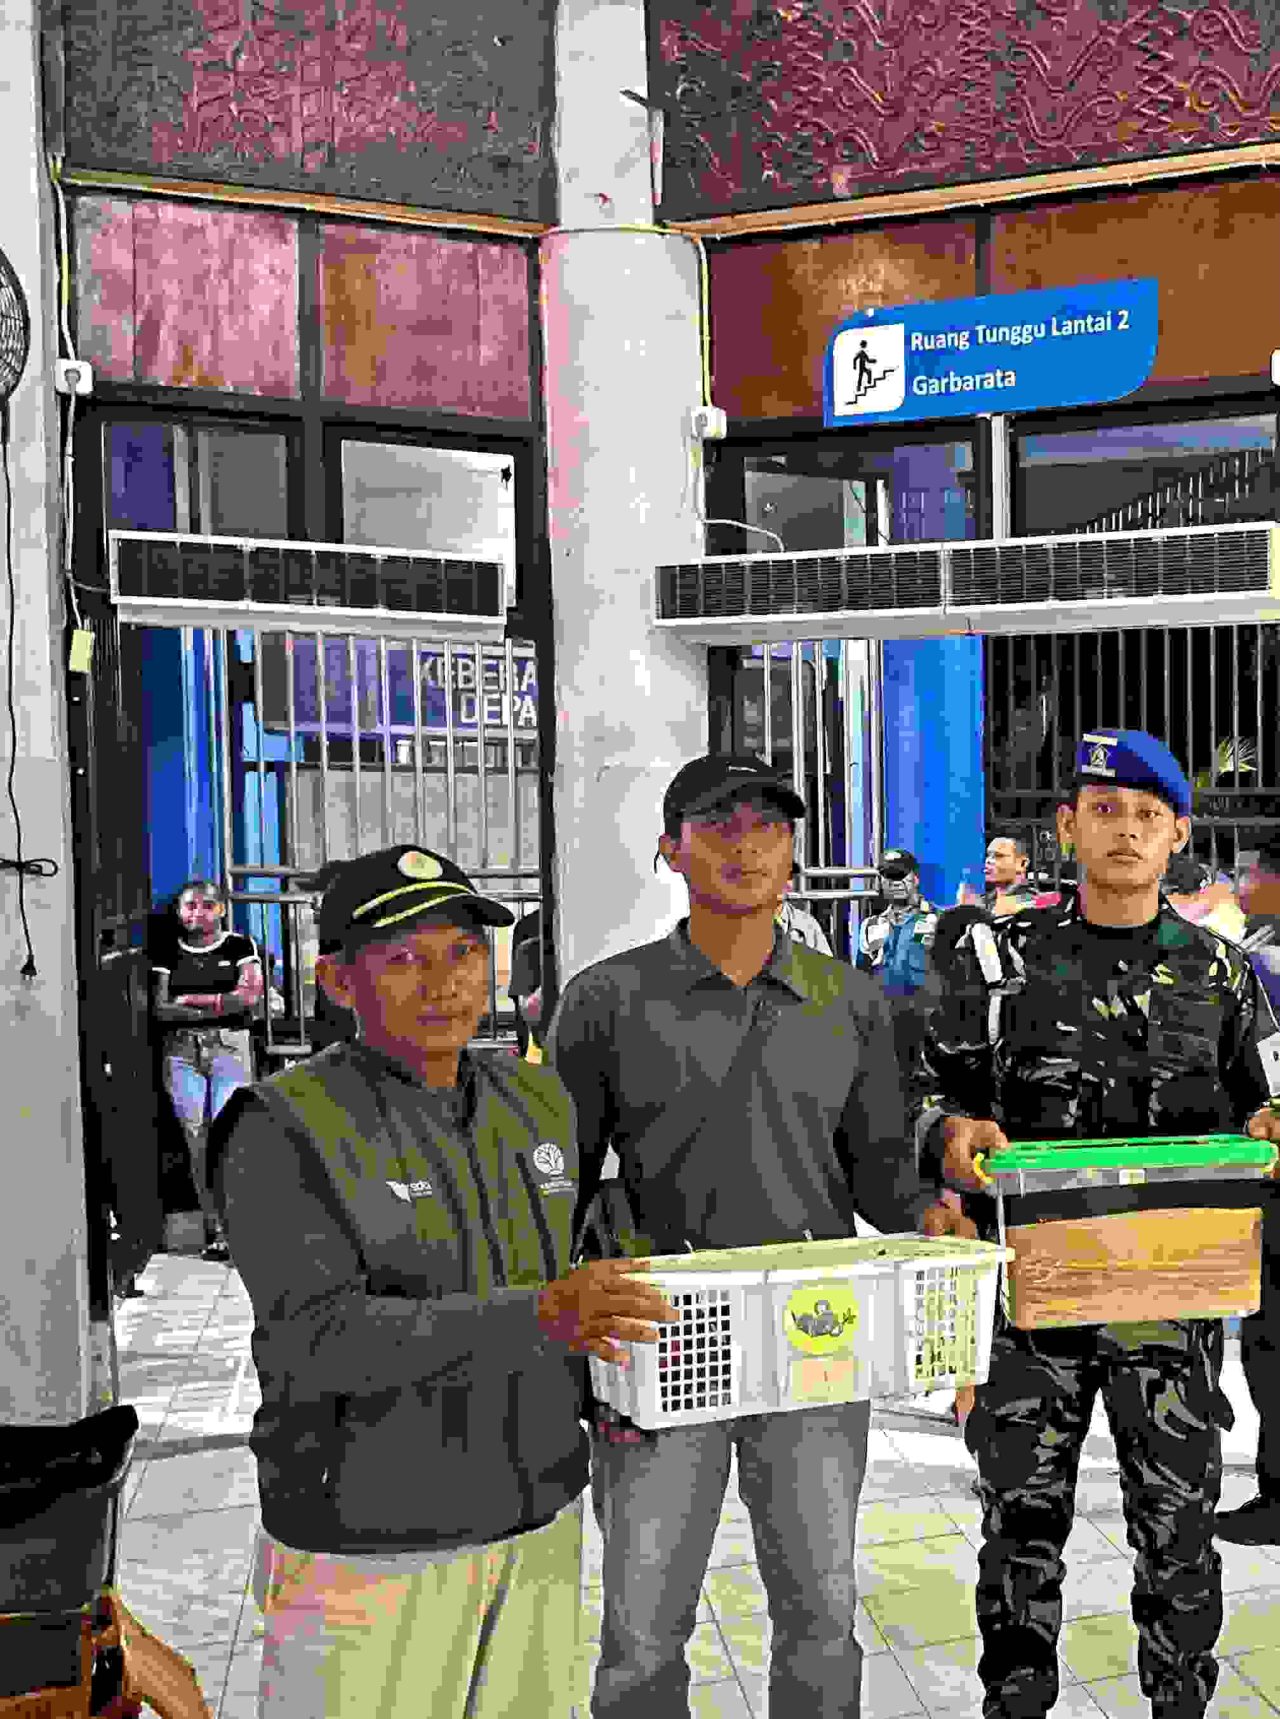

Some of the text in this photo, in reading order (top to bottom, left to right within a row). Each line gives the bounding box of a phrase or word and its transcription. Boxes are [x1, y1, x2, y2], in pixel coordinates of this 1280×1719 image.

[911, 310, 1129, 352] Ruang Tunggu Lantai 2
[912, 368, 1016, 396] Garbarata
